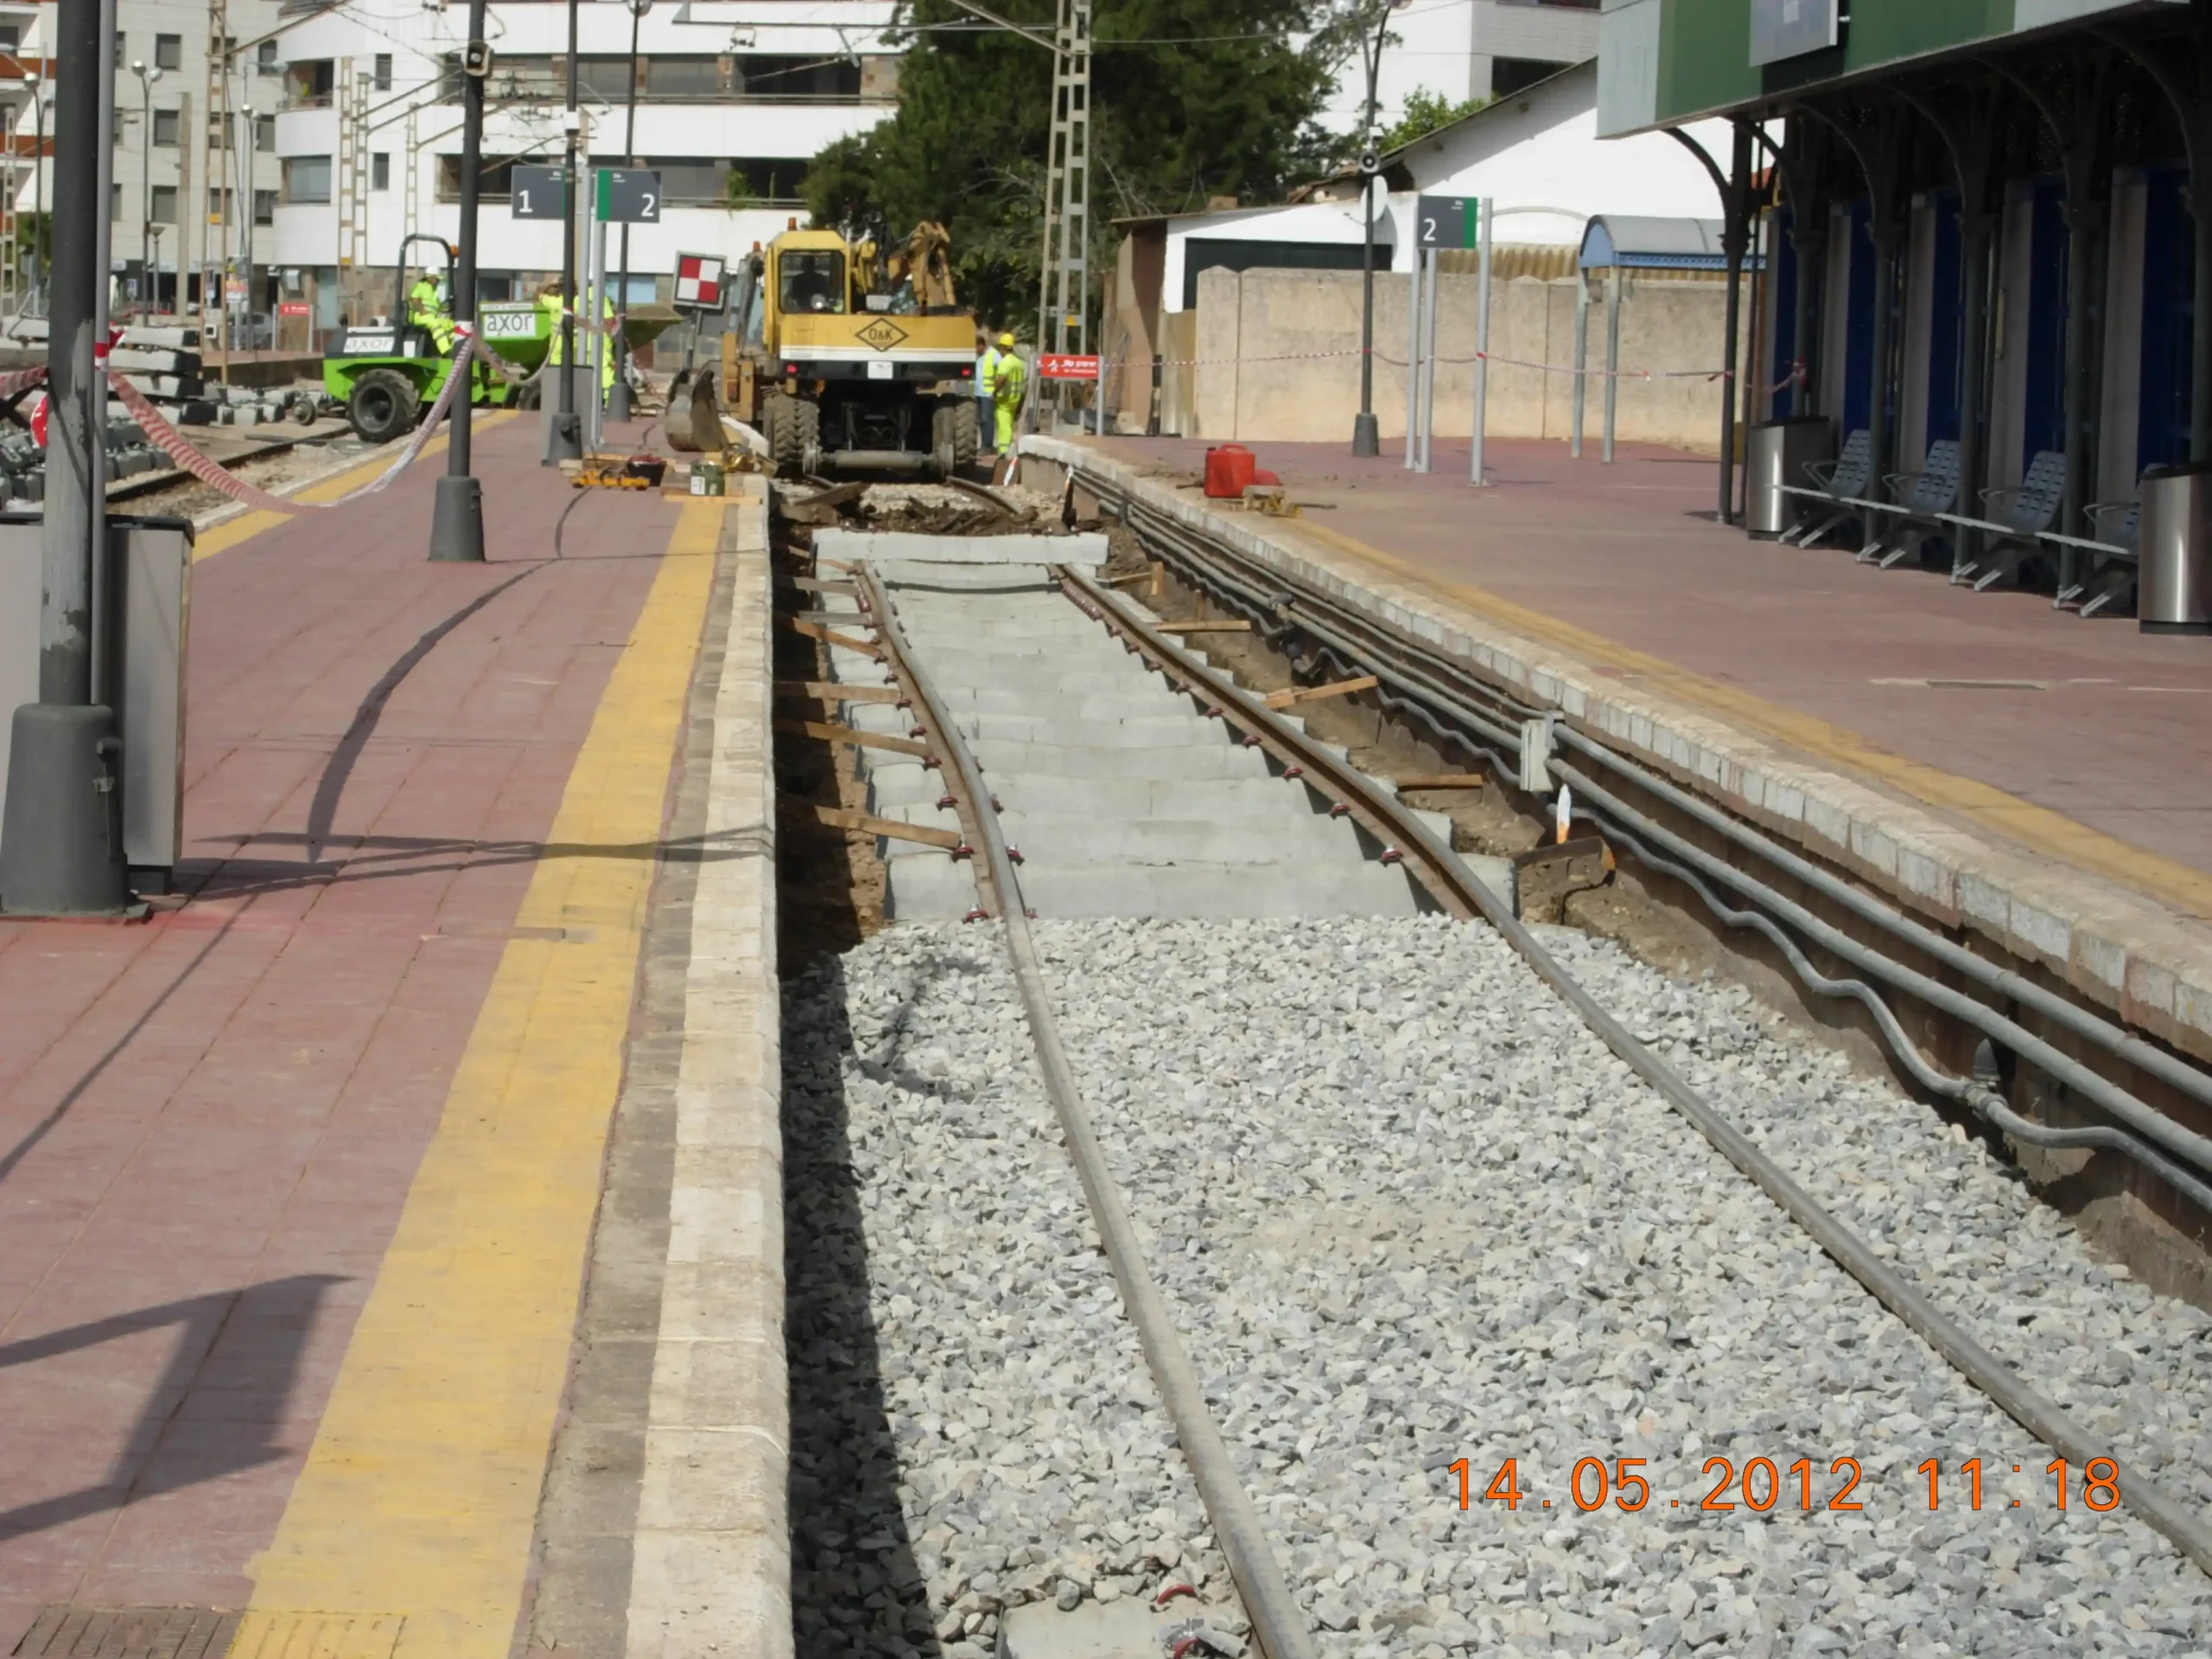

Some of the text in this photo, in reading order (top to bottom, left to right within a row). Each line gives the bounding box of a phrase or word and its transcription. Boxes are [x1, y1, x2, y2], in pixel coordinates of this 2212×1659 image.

[518, 189, 533, 213] 1
[641, 193, 655, 217] 2
[1423, 218, 1436, 241] 2
[486, 314, 532, 336] axor
[868, 328, 893, 340] O&K
